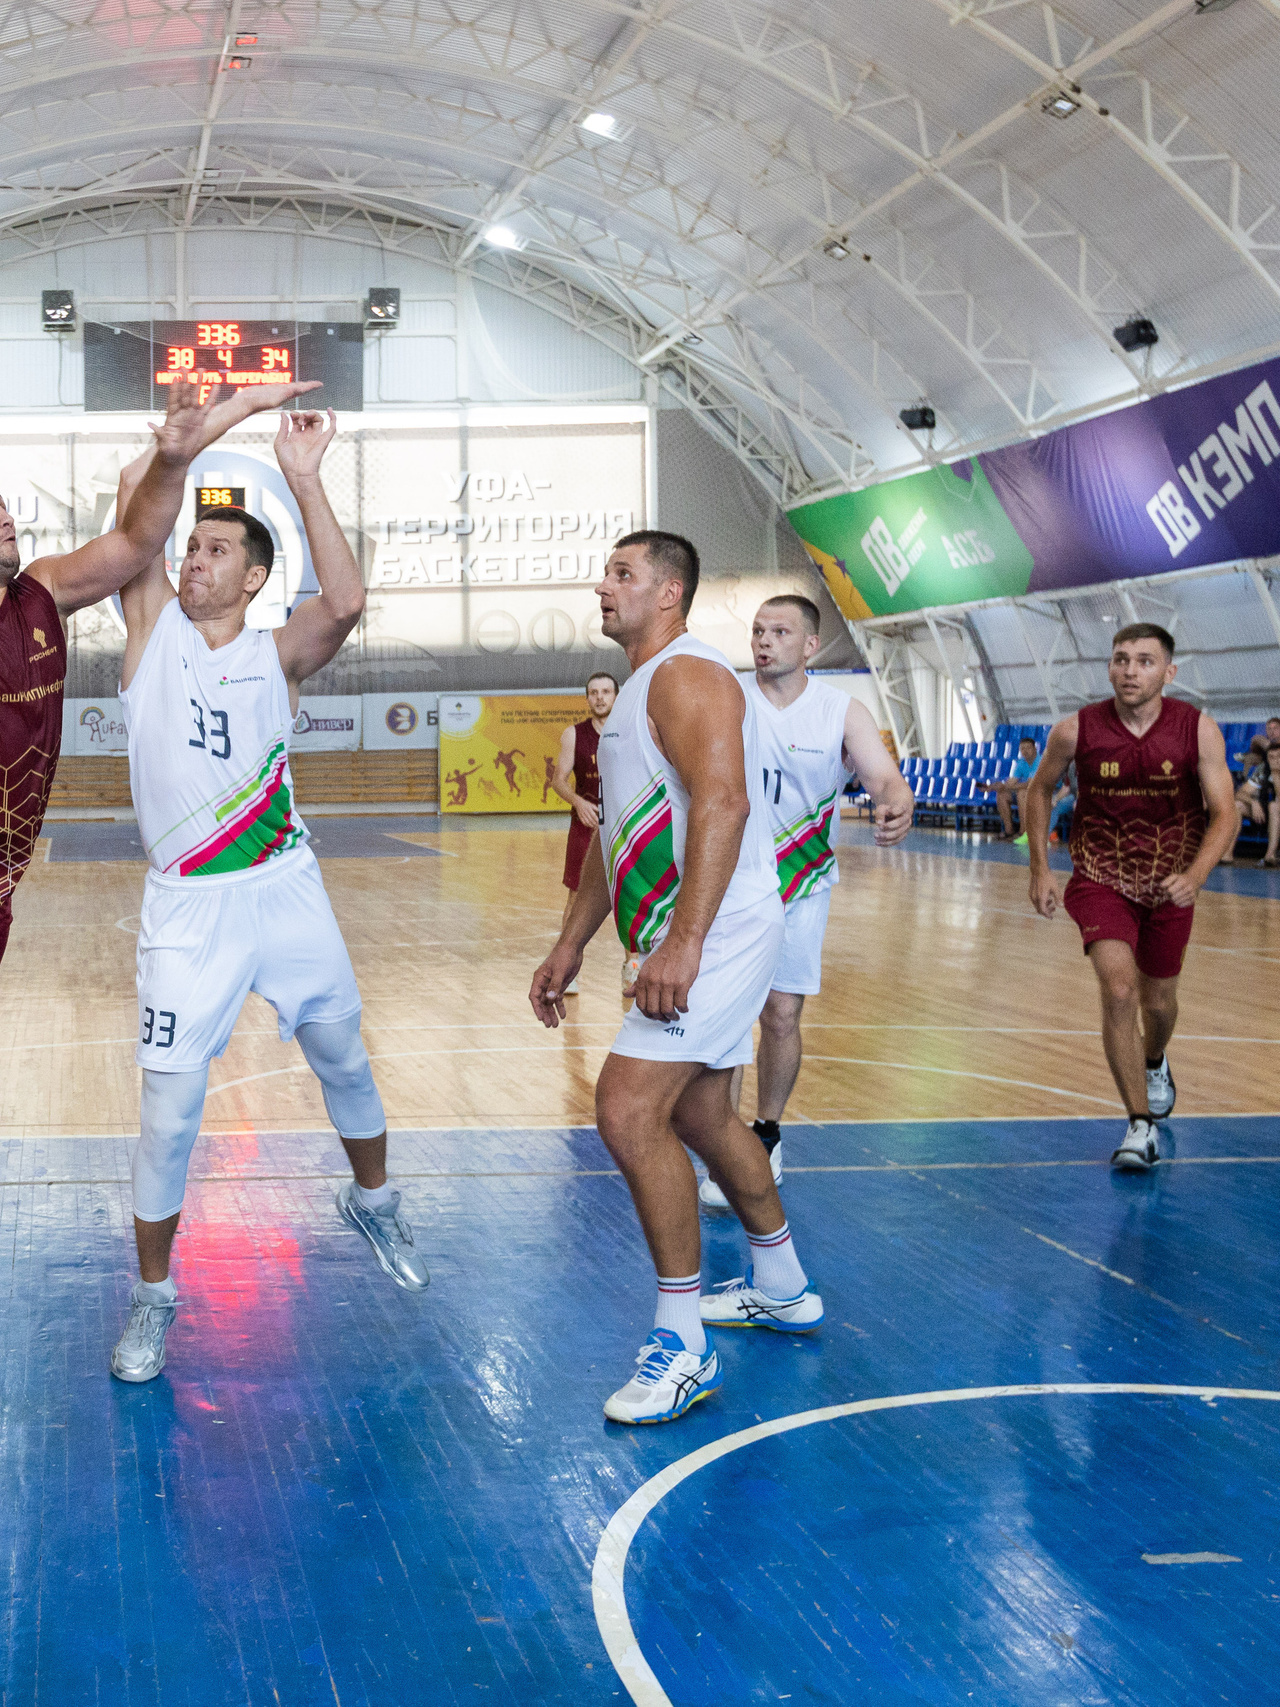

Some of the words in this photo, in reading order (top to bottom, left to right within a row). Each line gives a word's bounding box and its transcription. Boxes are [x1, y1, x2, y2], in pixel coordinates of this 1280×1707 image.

[217, 349, 233, 368] 4
[261, 347, 289, 370] 34
[1177, 379, 1280, 522] КЭМП
[441, 471, 552, 503] УФА-
[373, 508, 635, 545] ТЕРРИТОРИЯ
[375, 551, 608, 585] БАСКЕТБОЛ
[28, 645, 58, 664] РОСНЕФТ
[188, 698, 231, 760] 33
[1100, 761, 1119, 778] 88
[141, 1005, 177, 1048] 33
